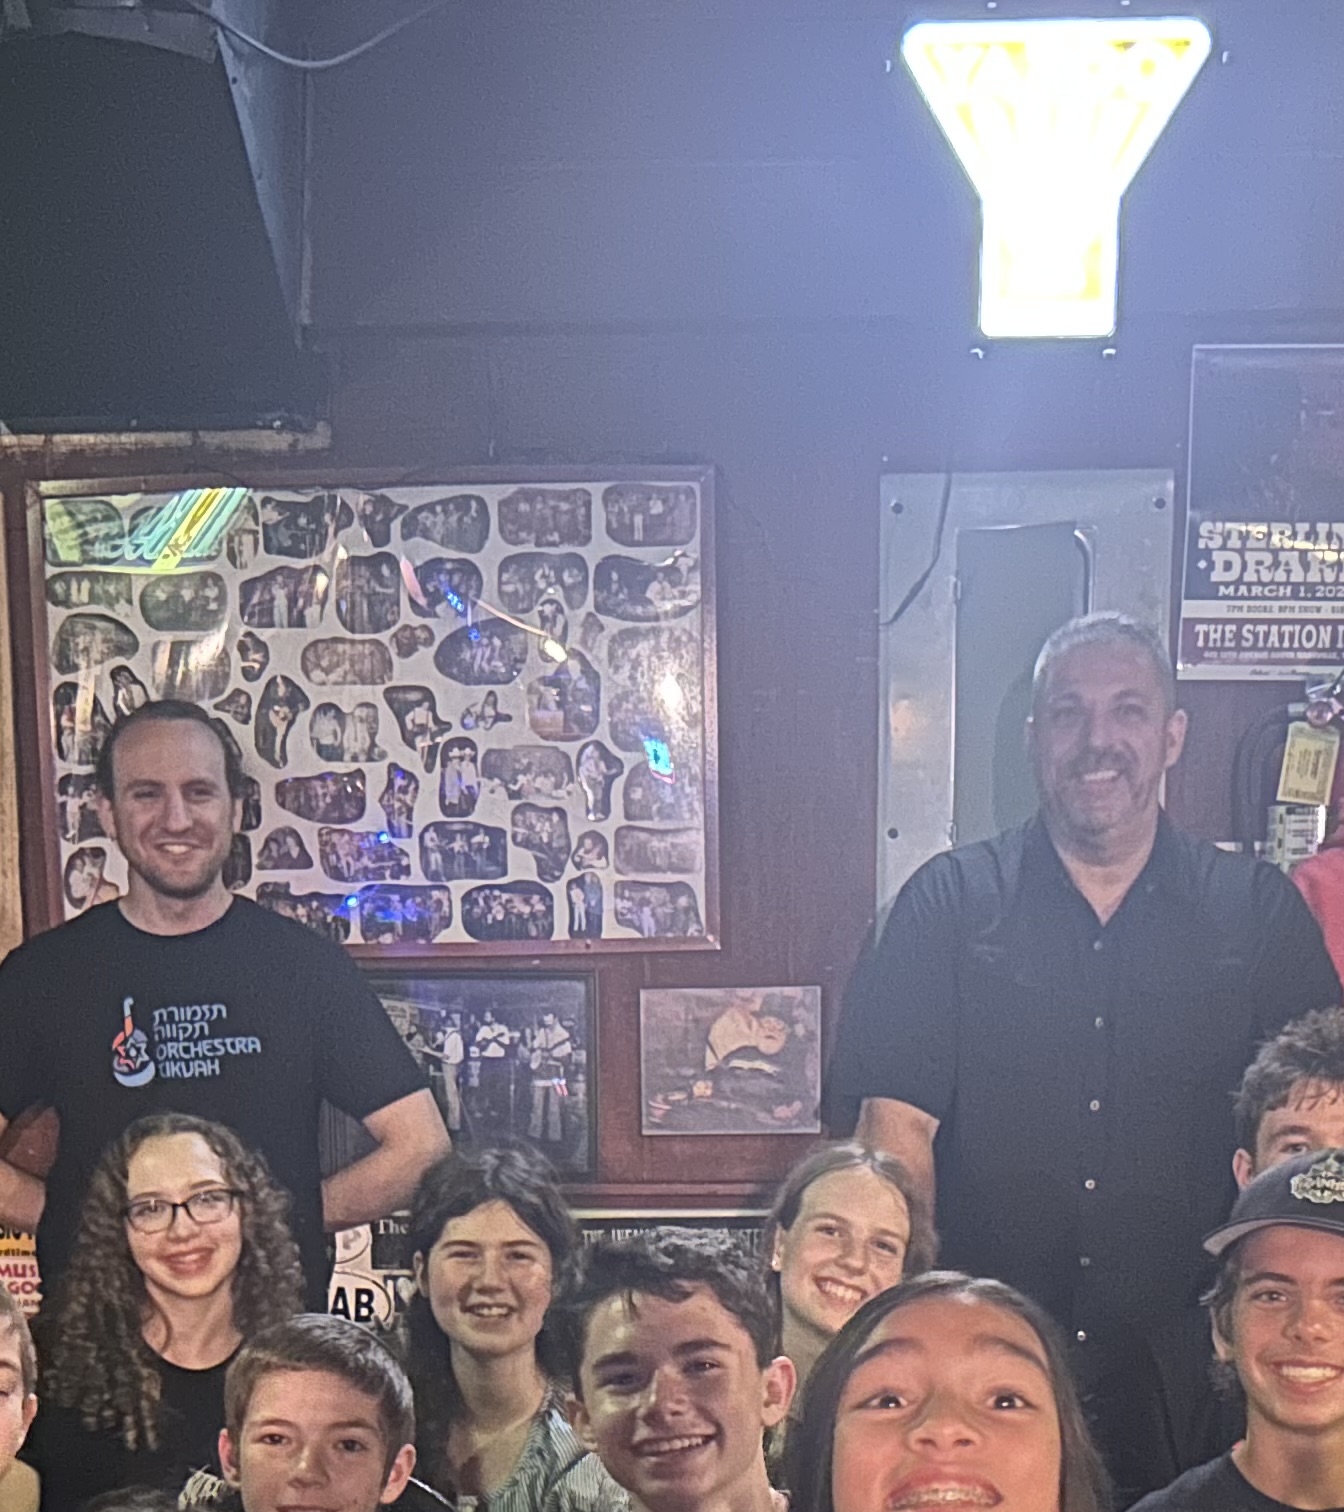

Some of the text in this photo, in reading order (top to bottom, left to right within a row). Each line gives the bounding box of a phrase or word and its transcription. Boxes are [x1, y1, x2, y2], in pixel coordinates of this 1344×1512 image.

[1218, 585, 1291, 597] MARCH
[1194, 624, 1237, 648] THE
[1241, 624, 1333, 649] STATION
[153, 1003, 227, 1026] תזמורת
[155, 1036, 262, 1061] ORCHESTRA
[377, 1219, 408, 1235] The
